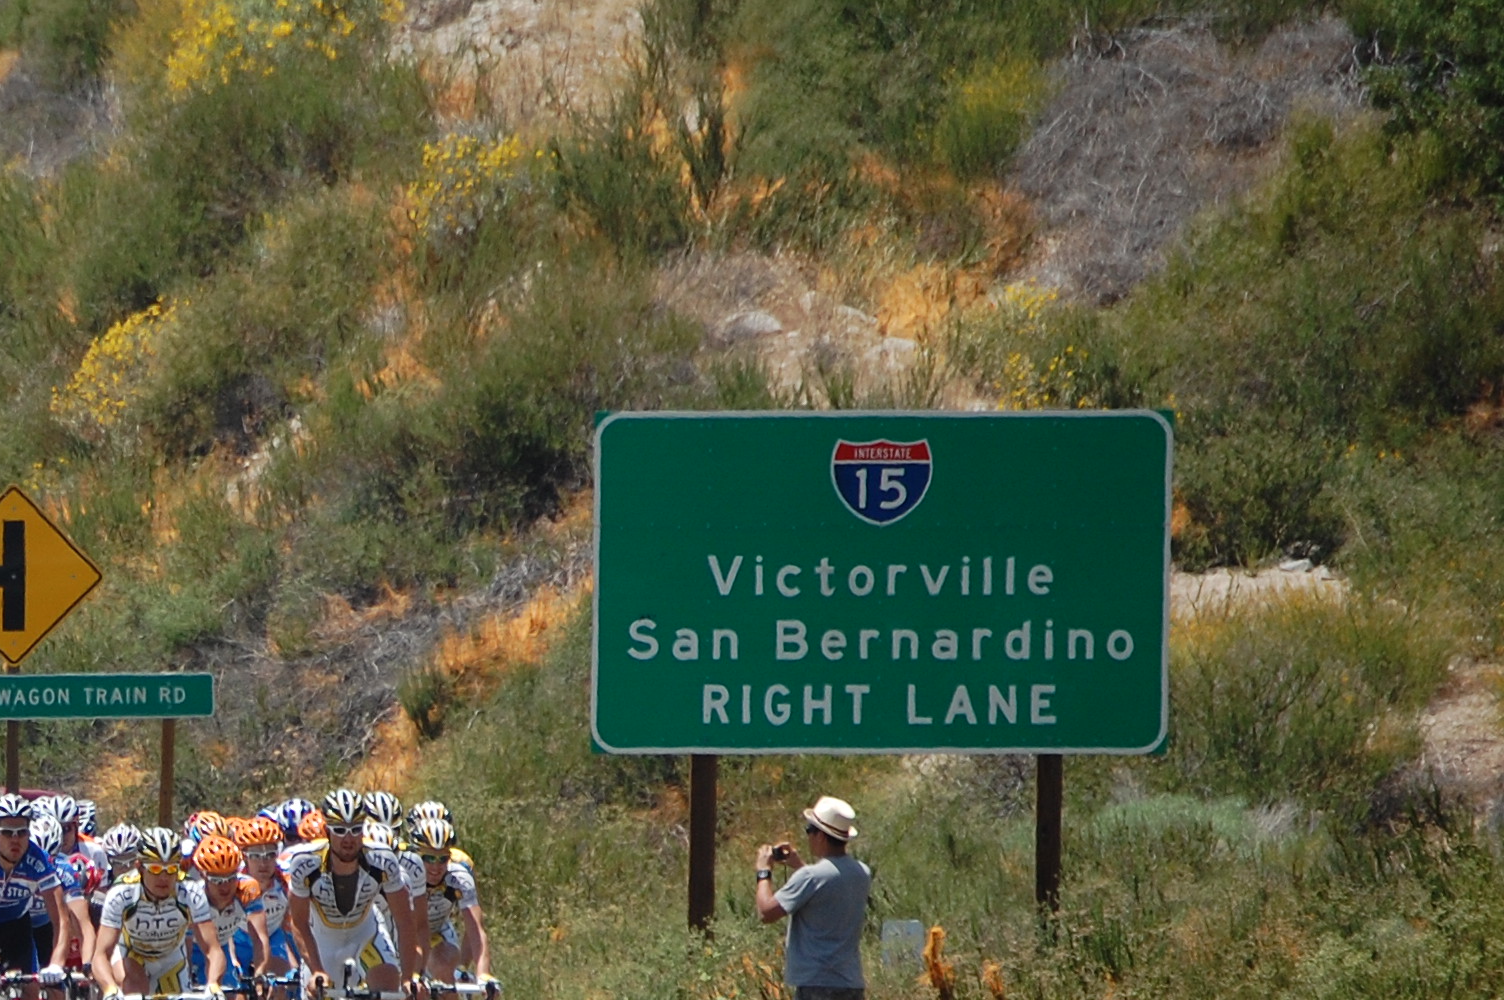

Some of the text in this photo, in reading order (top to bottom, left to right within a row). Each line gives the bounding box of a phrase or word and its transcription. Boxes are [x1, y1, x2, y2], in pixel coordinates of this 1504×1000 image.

[854, 447, 912, 459] INTERSTATE
[855, 467, 908, 510] 15
[707, 554, 1054, 597] Victorville
[627, 618, 1135, 661] San Bernardino
[84, 687, 147, 705] TRAIN
[159, 687, 187, 704] RD
[702, 683, 1057, 725] RIGHT LANE
